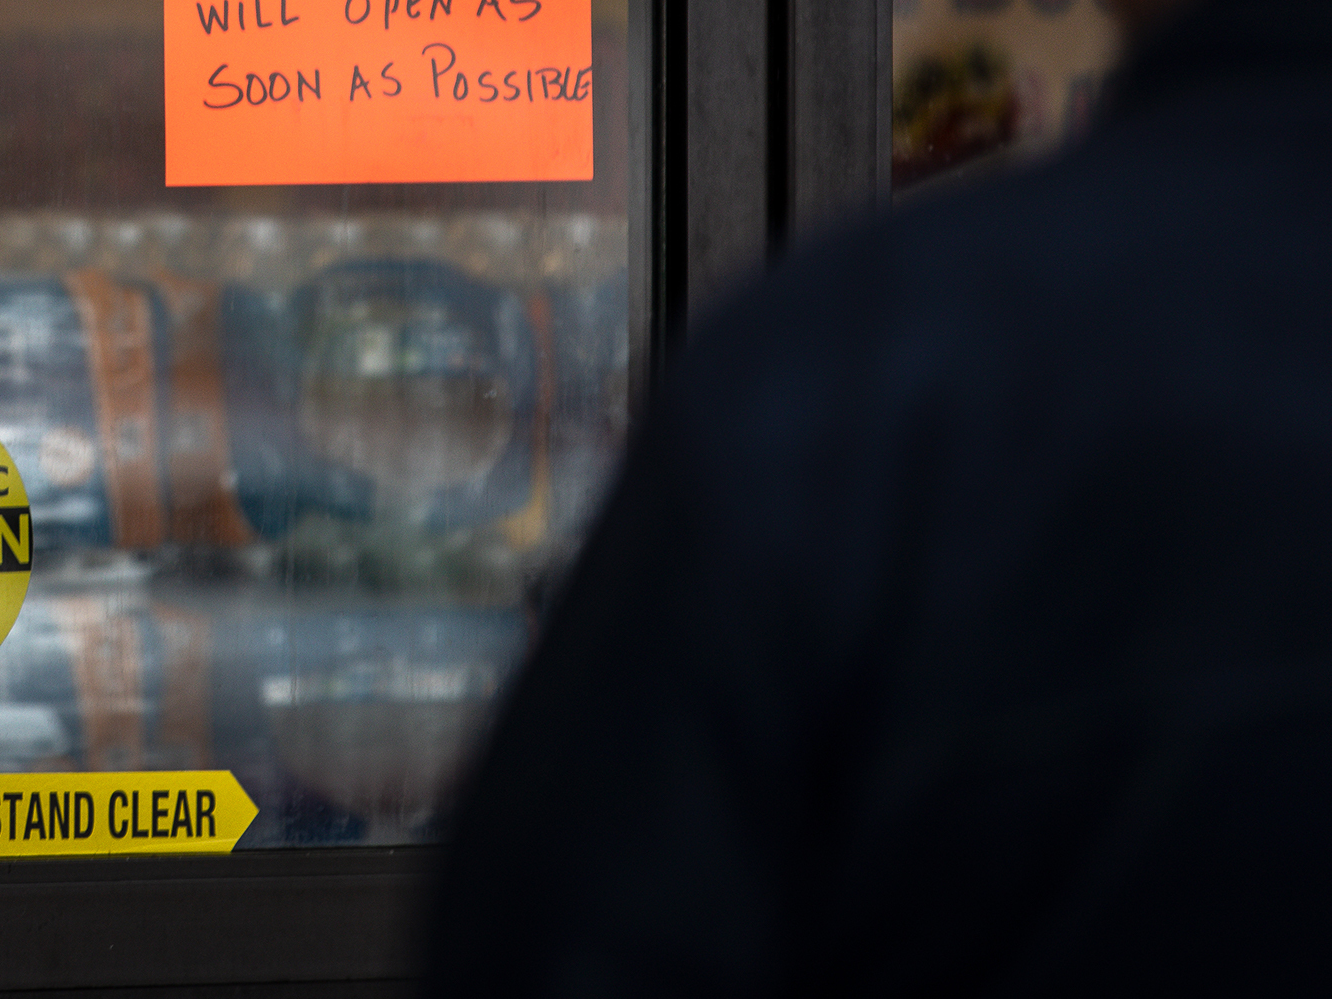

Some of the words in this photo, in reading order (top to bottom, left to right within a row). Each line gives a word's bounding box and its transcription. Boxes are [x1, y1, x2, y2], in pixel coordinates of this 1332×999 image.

[203, 63, 321, 109] SOON
[350, 62, 403, 101] AS
[422, 43, 593, 102] POSSIBLE
[108, 789, 217, 839] CLEAR
